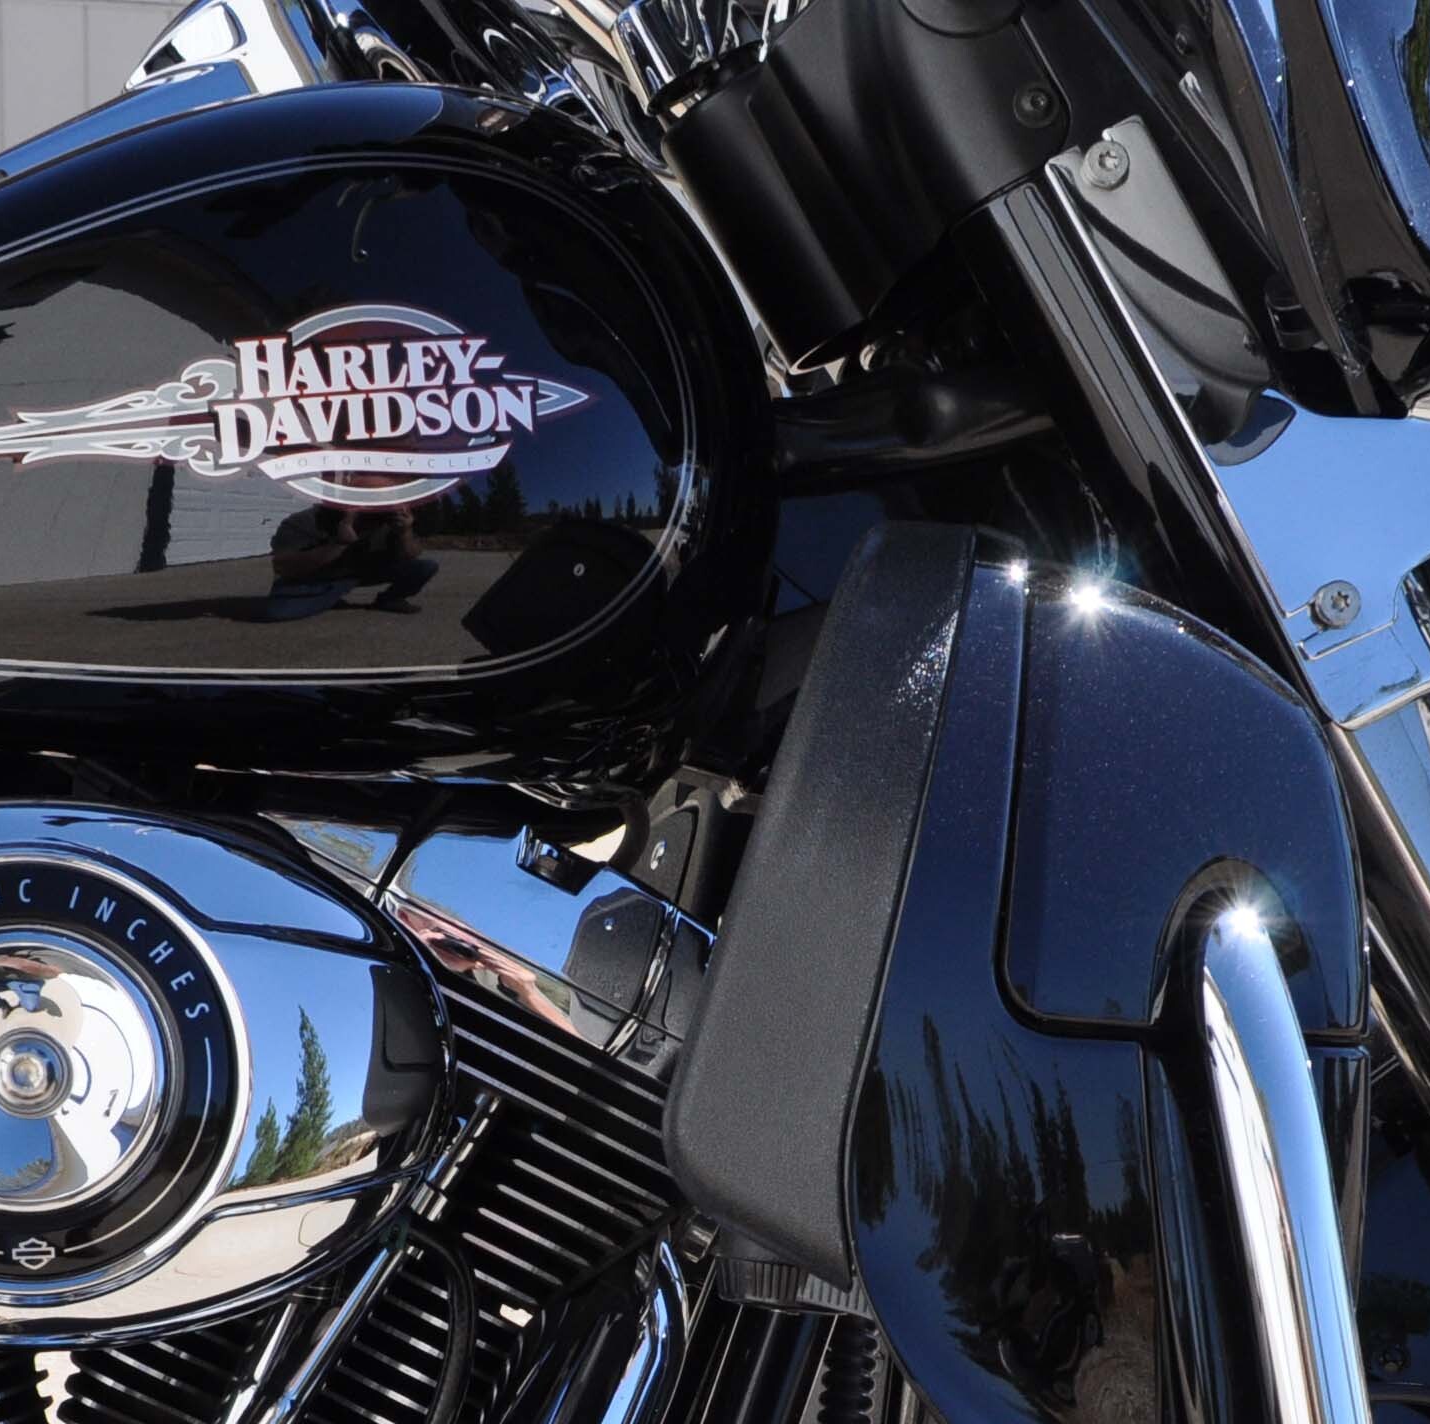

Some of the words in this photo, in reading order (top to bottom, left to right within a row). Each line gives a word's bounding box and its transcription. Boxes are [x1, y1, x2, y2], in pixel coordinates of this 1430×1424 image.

[234, 336, 506, 400] HARLEY-
[213, 384, 535, 465] DAVIDSON
[273, 453, 494, 472] MOTORCYCLES
[69, 885, 210, 1020] INCHES
